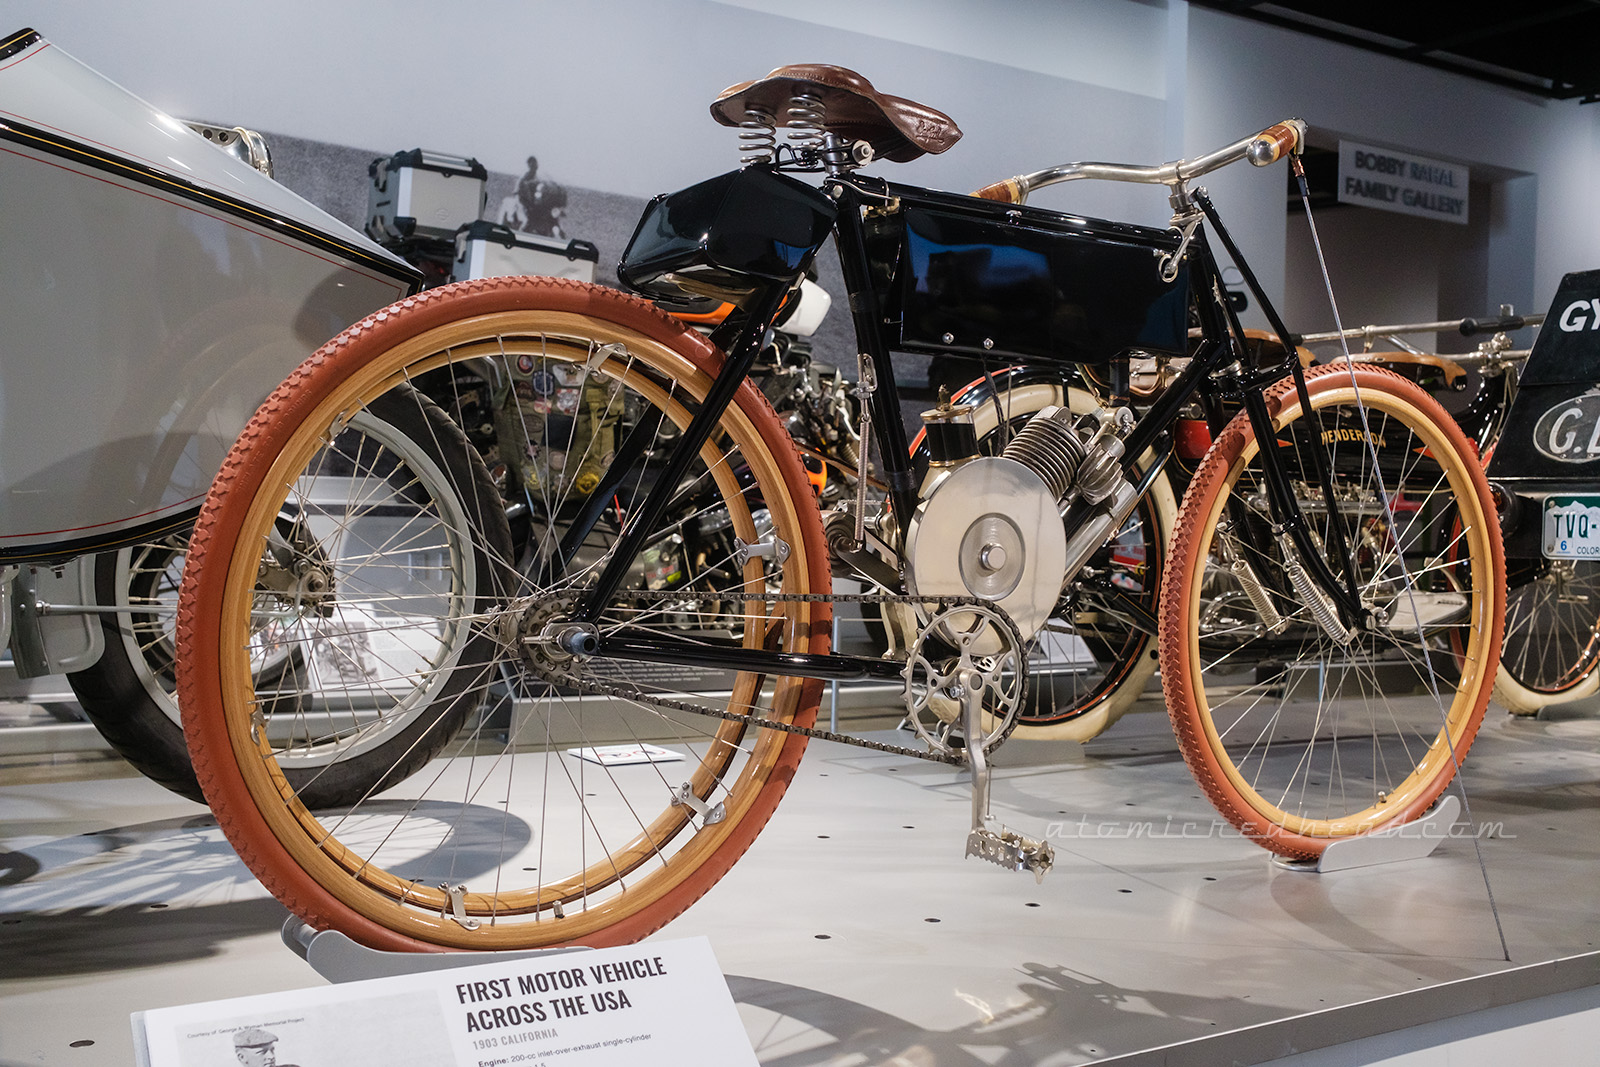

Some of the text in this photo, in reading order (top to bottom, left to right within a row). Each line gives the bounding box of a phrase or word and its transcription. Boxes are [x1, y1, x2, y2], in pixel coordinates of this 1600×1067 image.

[1354, 150, 1405, 177] BOBBY
[1345, 177, 1465, 216] FAMILY GALLERY
[1560, 540, 1567, 551] 6
[456, 956, 668, 1005] FIRST MOTOR VEHICLE
[466, 988, 632, 1033] ACROSS THE USA
[472, 1028, 559, 1051] 1903 CALIFORNIA
[478, 1034, 652, 1067] Engine: 200-cc inlet-over-exhaust single-cylinder
